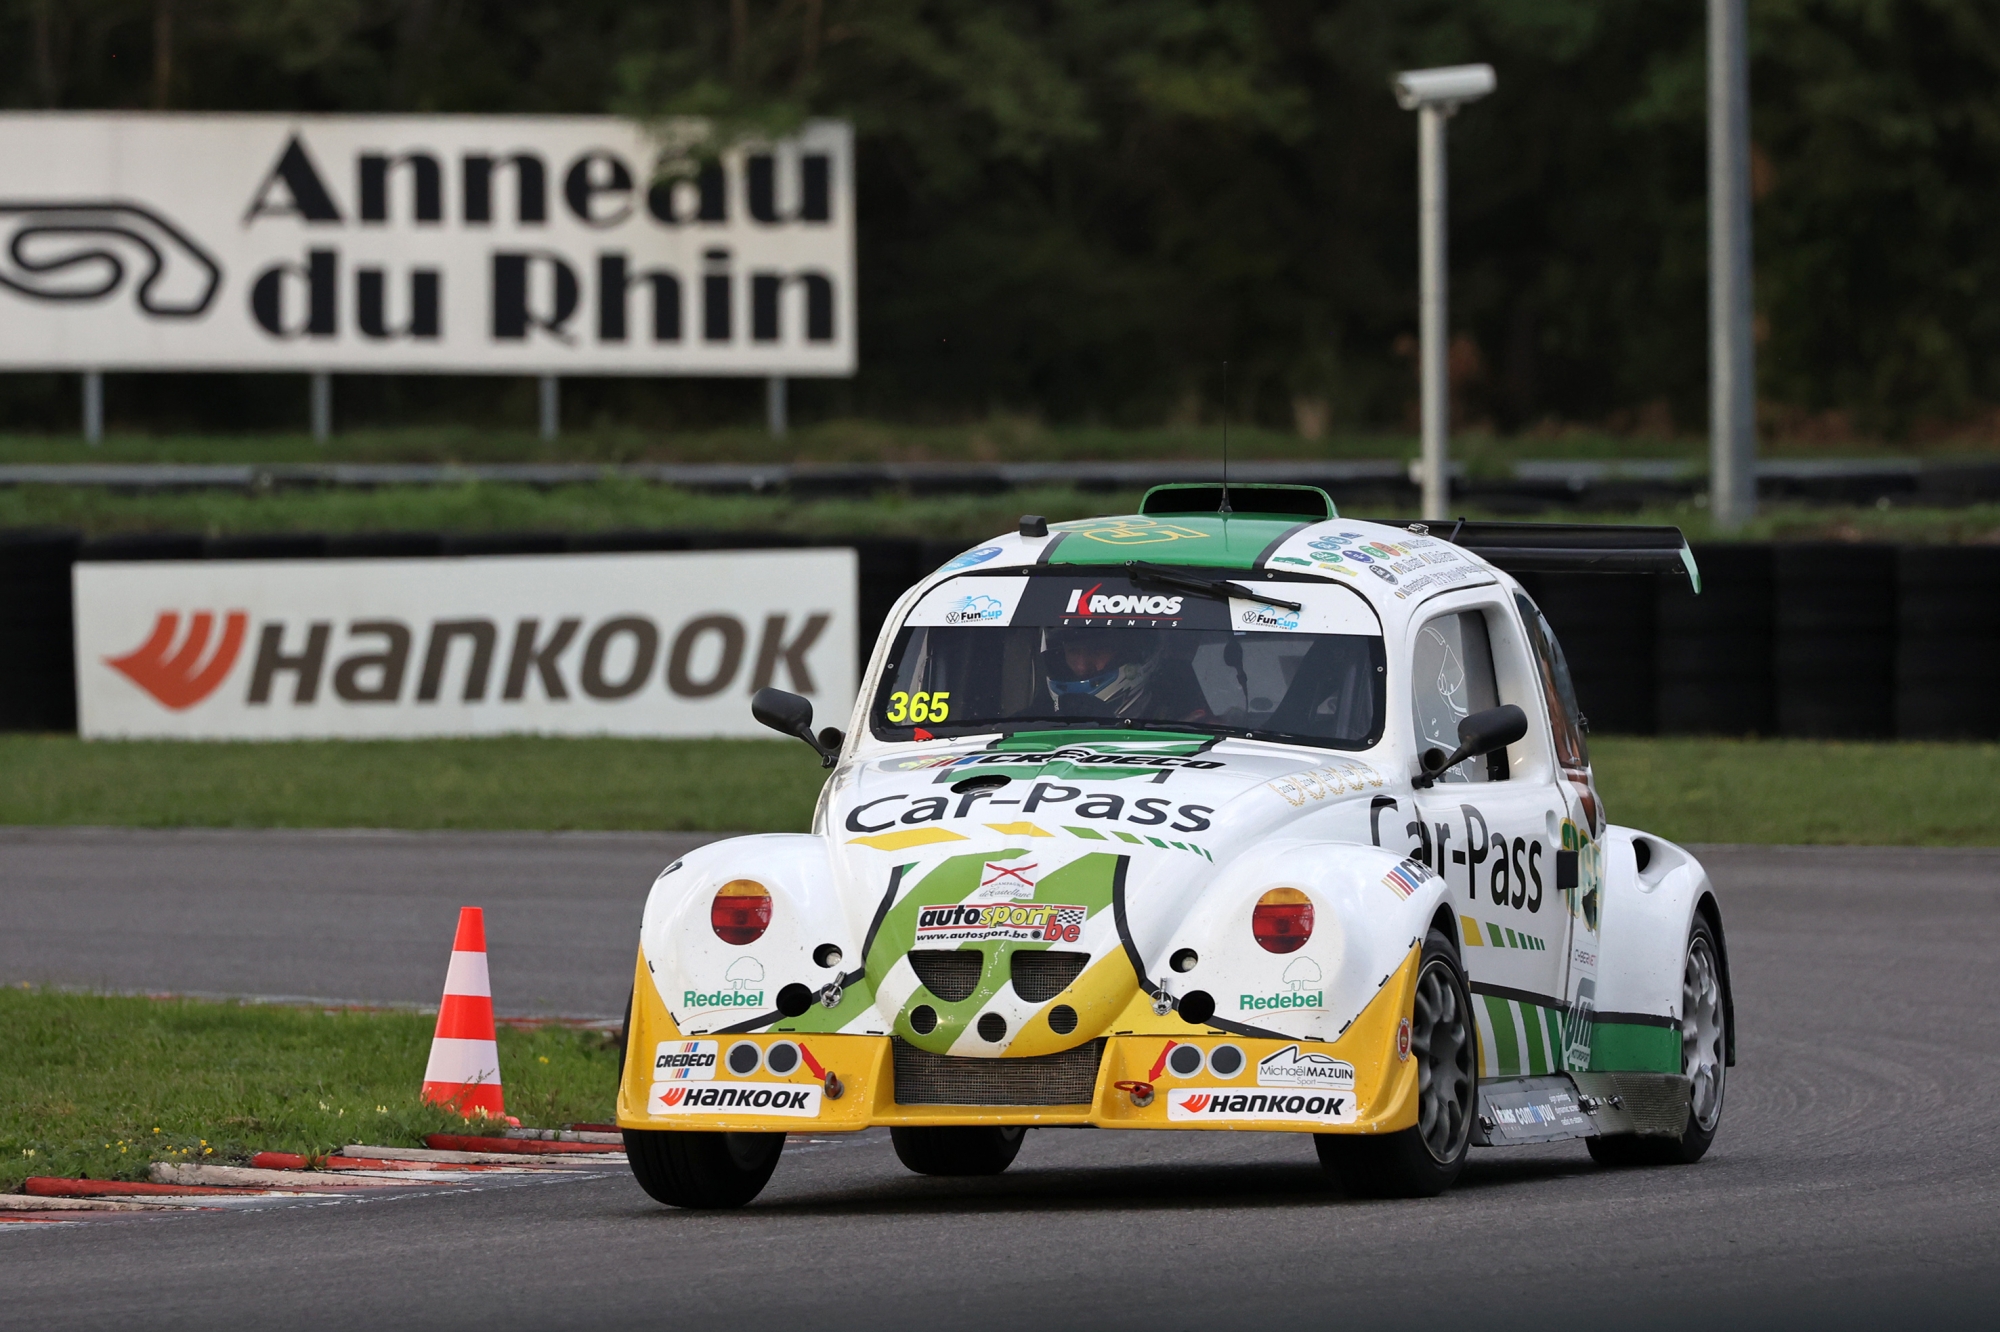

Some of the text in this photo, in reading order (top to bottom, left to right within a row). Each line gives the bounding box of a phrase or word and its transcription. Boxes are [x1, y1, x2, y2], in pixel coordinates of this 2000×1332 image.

[242, 129, 838, 229] Anneau
[249, 246, 839, 347] du Rhin
[1065, 583, 1184, 615] KRONOS
[961, 609, 1003, 621] FunCup
[1063, 618, 1178, 627] EVENTS
[1257, 614, 1299, 630] FunCup
[887, 691, 950, 723] 365
[977, 749, 1226, 770] CREDECO
[845, 782, 1216, 833] Car-Pass
[917, 929, 1028, 941] www.autosport.be
[683, 990, 764, 1008] Redebel
[1240, 991, 1323, 1010] Redebel
[656, 1054, 716, 1068] CREDECO
[1296, 1077, 1317, 1086] Sport
